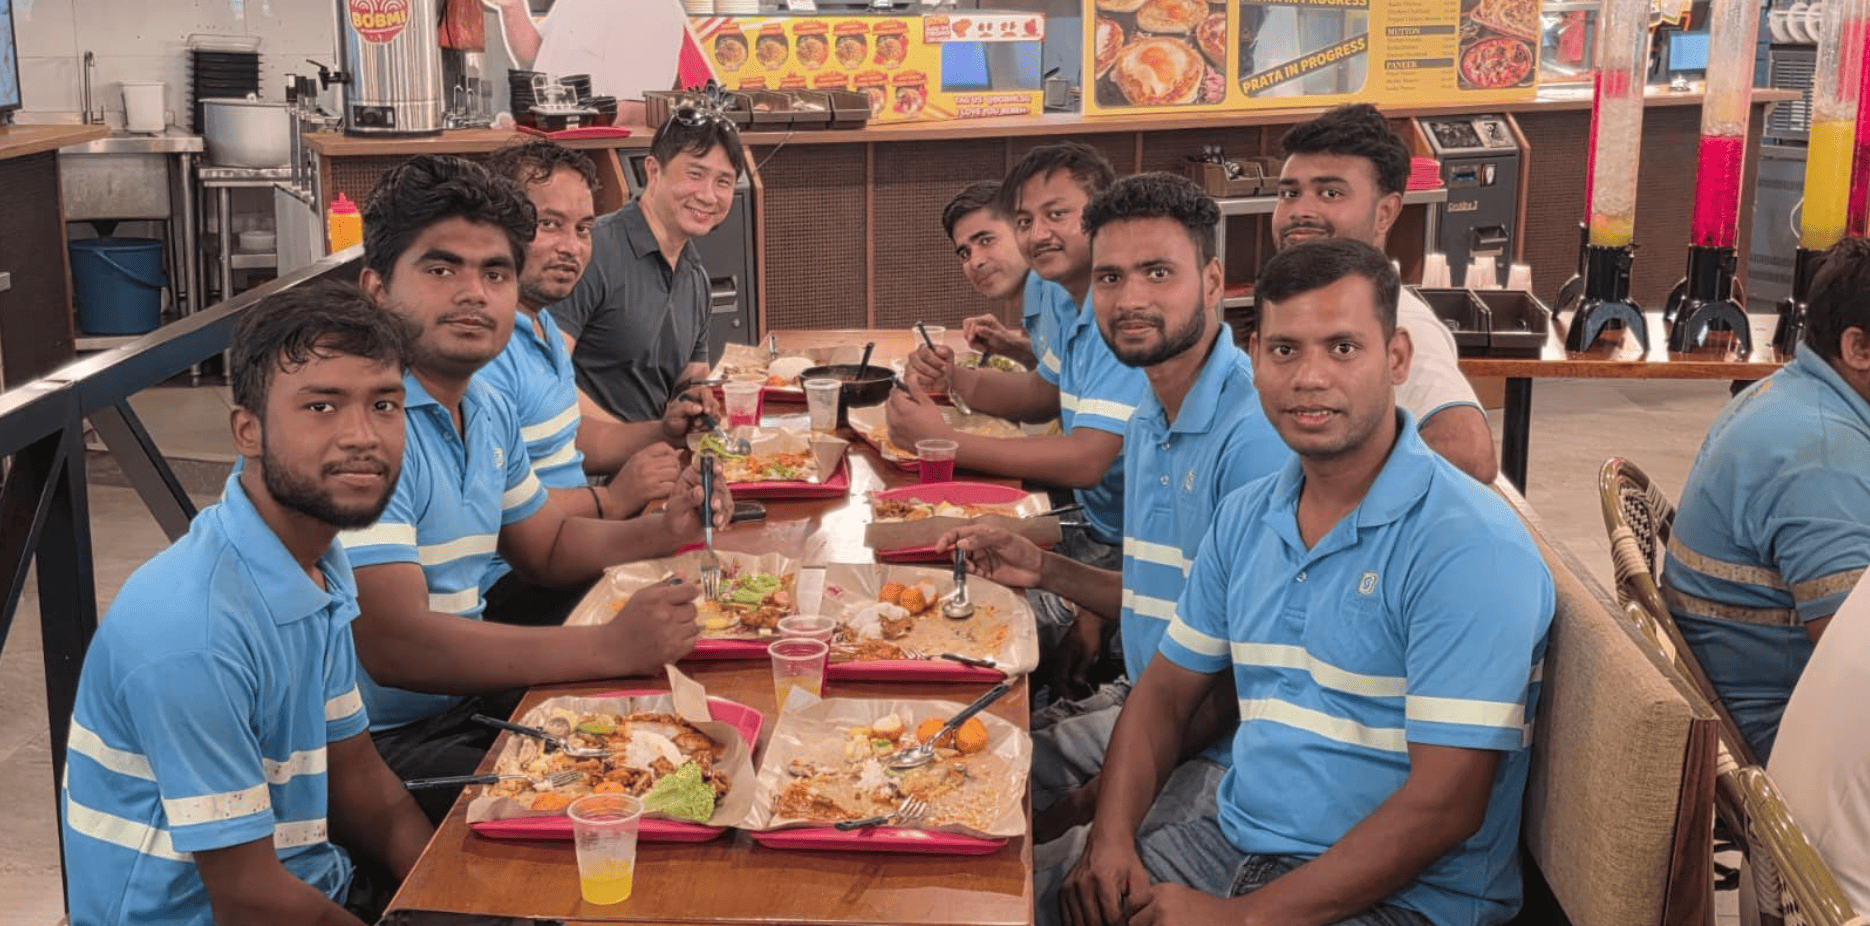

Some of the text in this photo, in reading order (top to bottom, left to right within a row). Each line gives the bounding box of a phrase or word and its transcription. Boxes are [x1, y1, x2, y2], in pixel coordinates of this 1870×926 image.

[352, 10, 406, 29] BOBMI
[1387, 27, 1420, 36] MUTTON
[1242, 69, 1284, 94] PRATA
[1284, 62, 1300, 79] IN
[1300, 37, 1366, 72] PROGRESS
